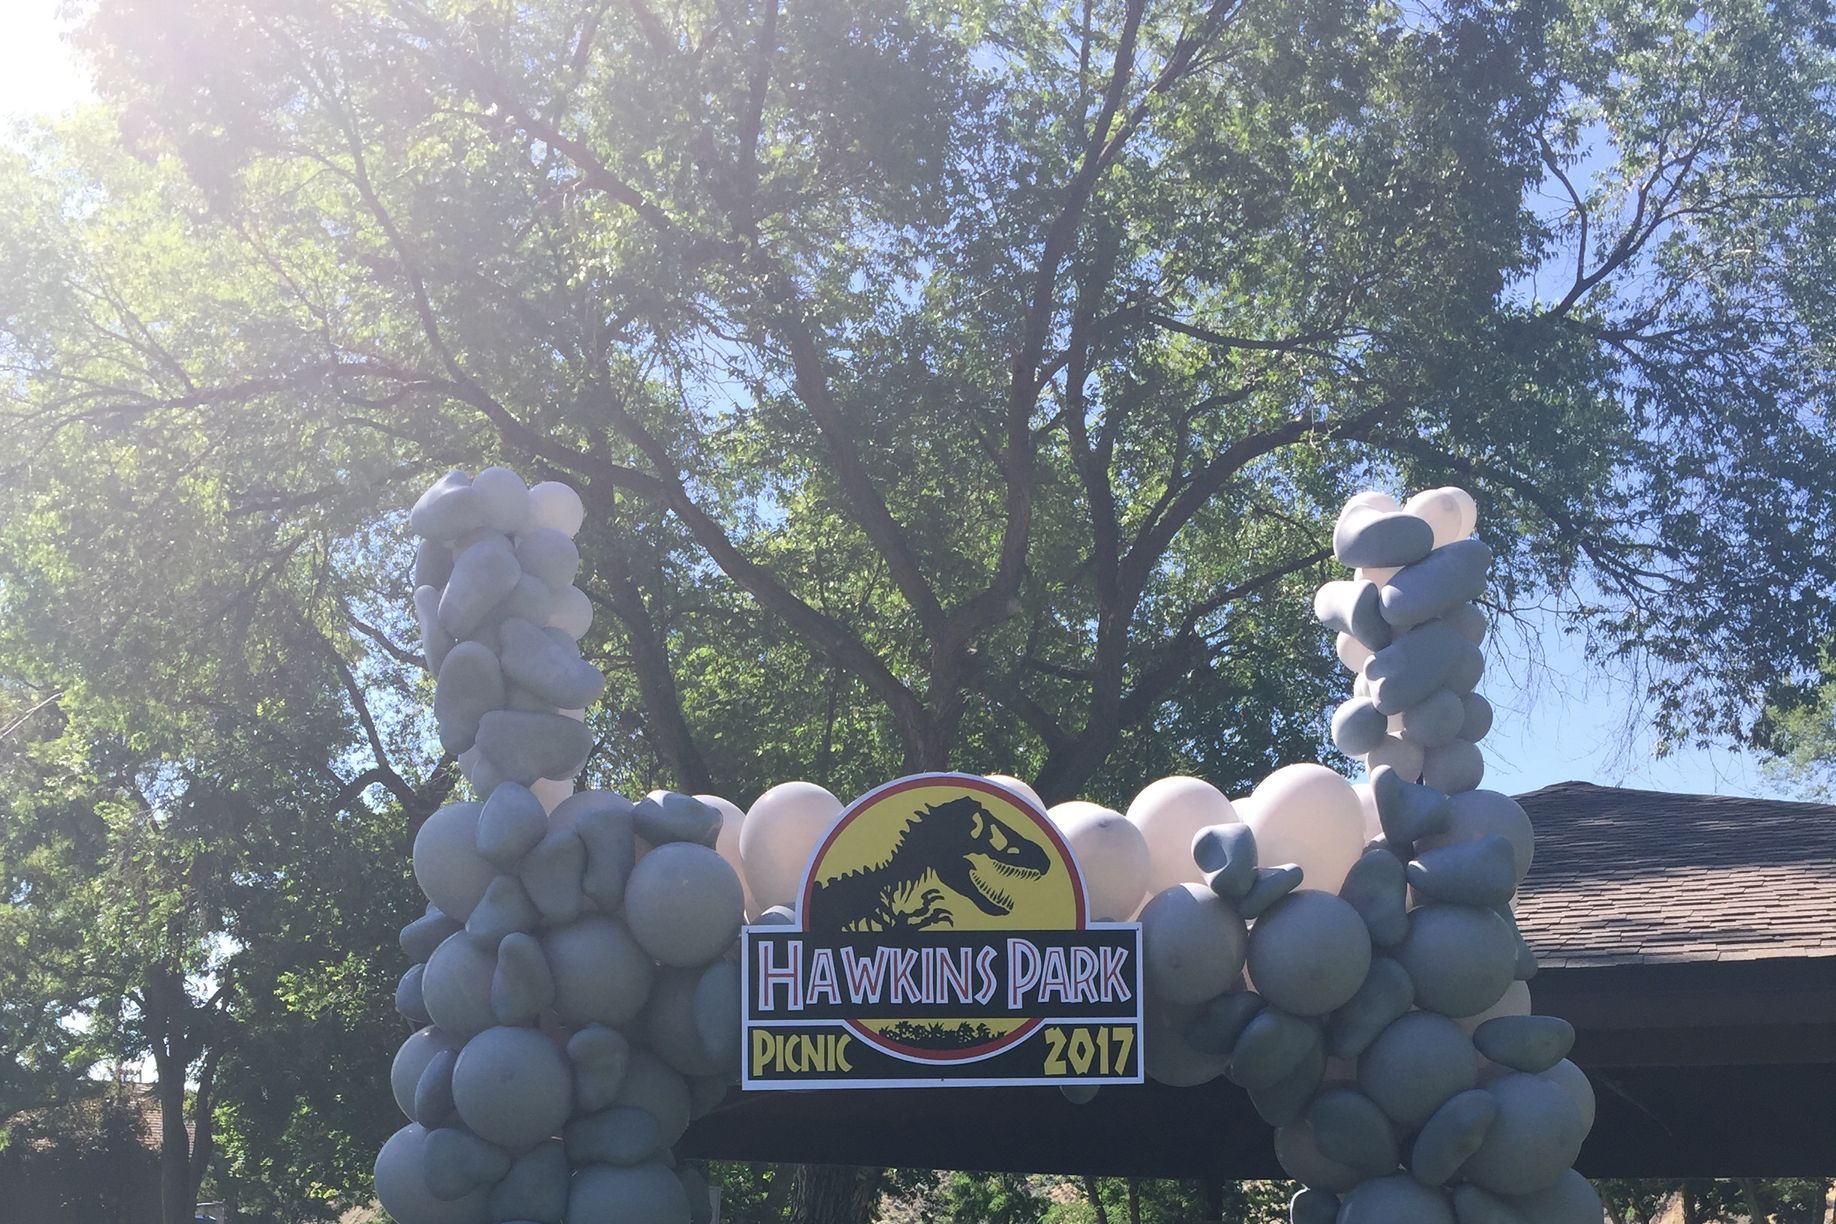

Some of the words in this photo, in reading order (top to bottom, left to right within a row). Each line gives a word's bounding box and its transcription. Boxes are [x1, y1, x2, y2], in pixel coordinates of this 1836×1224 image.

[758, 940, 998, 1011] HAWKINS
[1007, 938, 1132, 1010] PARK
[752, 1029, 853, 1077] PICNIC
[1043, 1026, 1134, 1076] 2017
